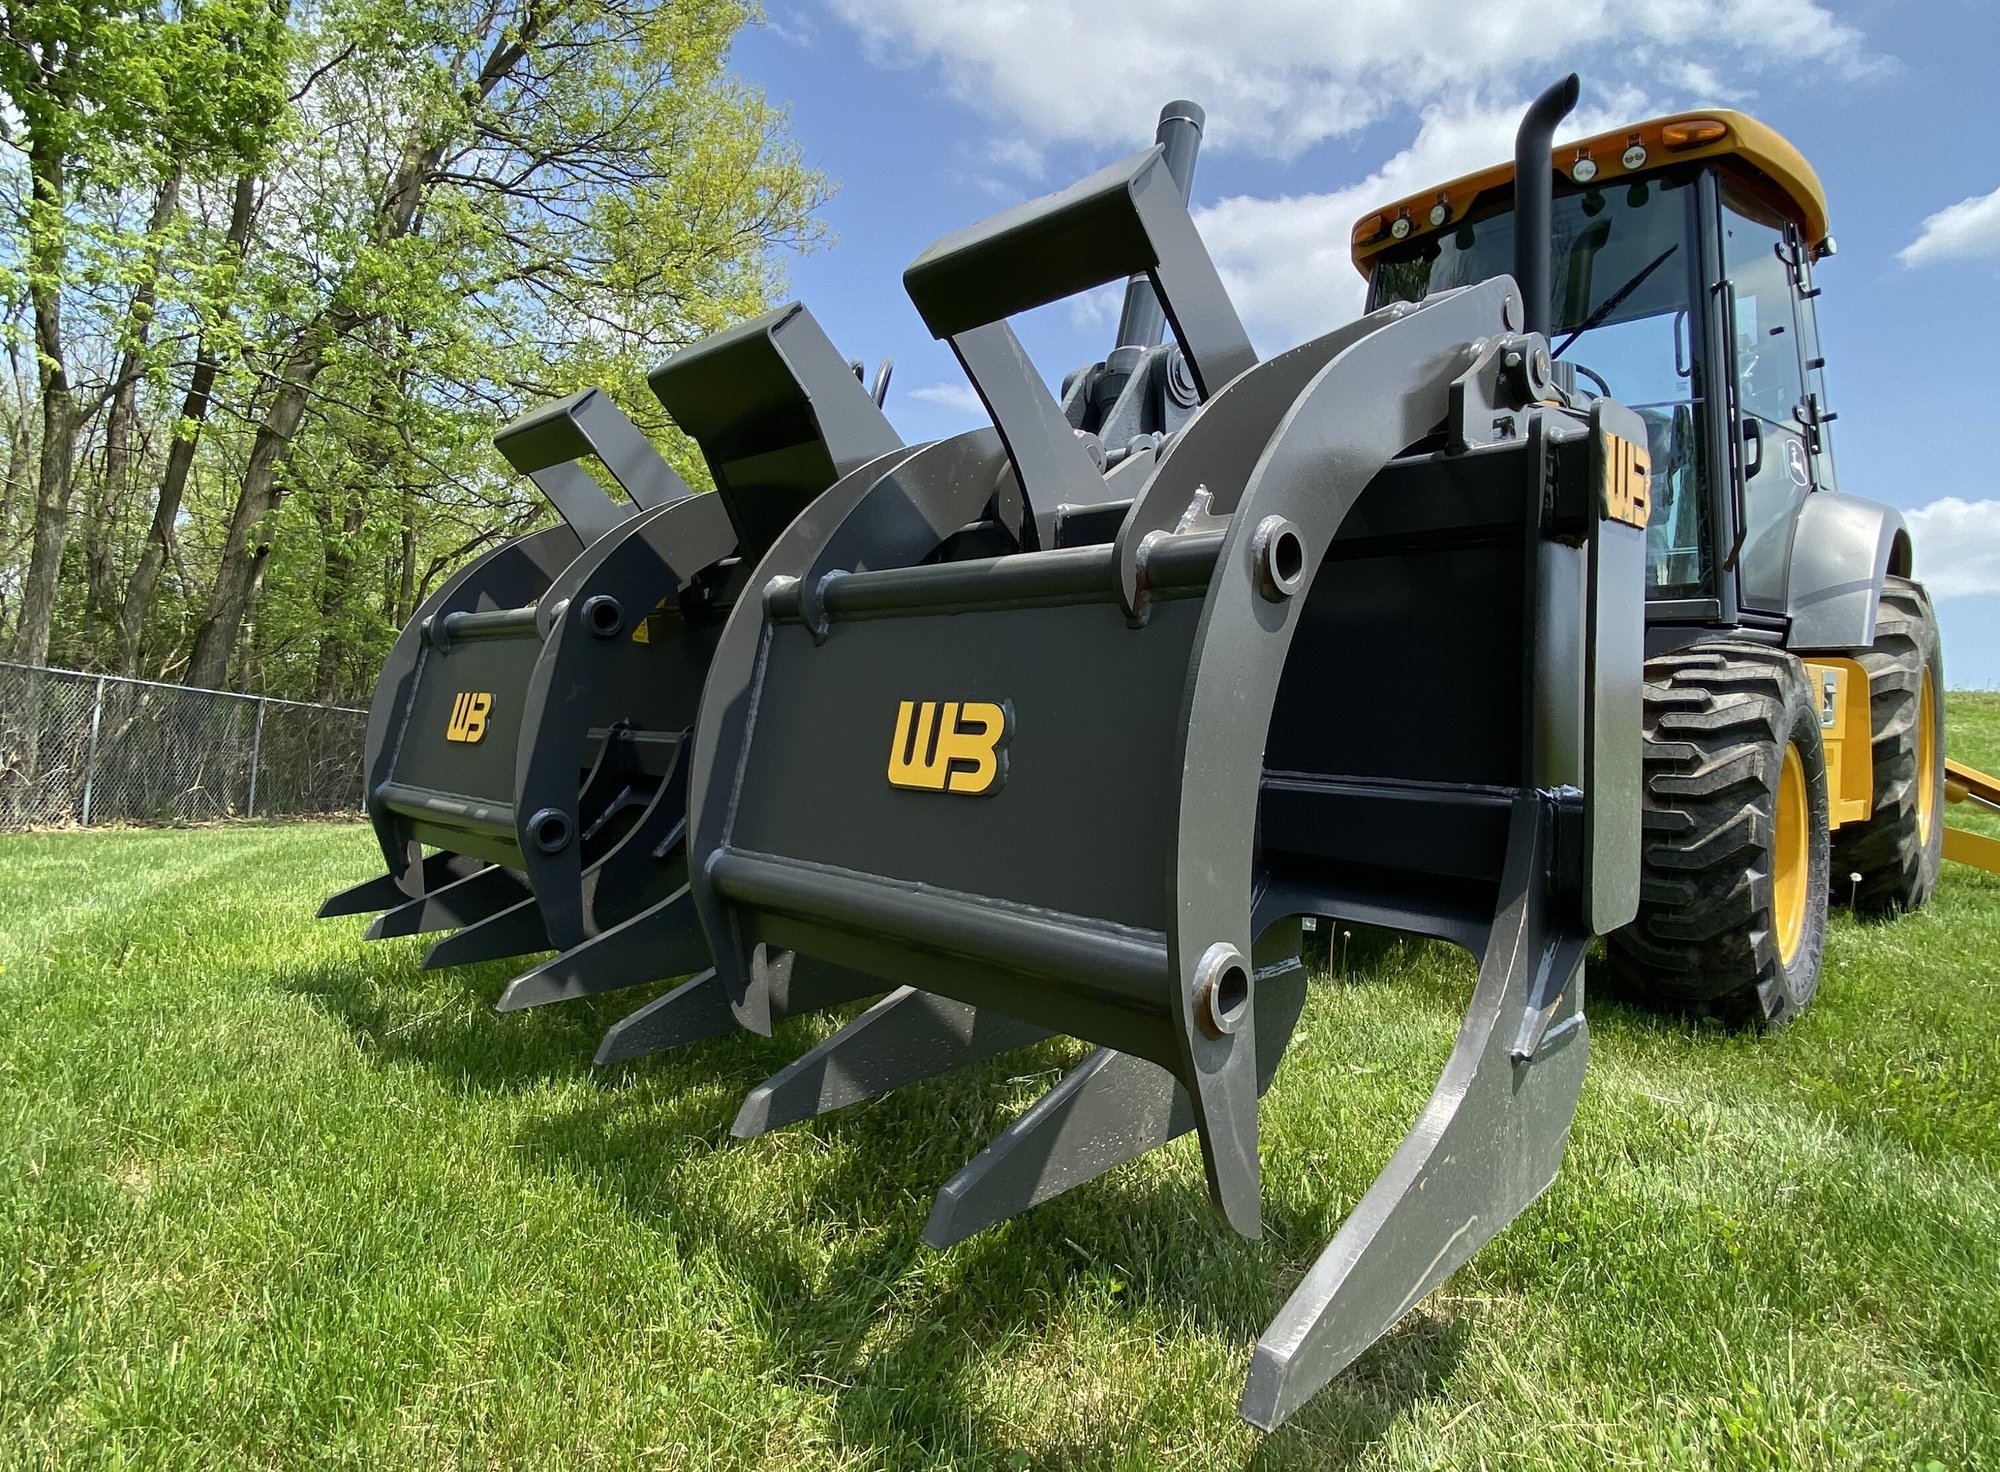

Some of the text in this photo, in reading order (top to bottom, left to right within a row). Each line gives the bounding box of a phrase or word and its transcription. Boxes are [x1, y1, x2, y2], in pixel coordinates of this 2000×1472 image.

[1606, 432, 1651, 527] WB
[447, 693, 492, 742] WB
[887, 702, 1006, 792] WB
